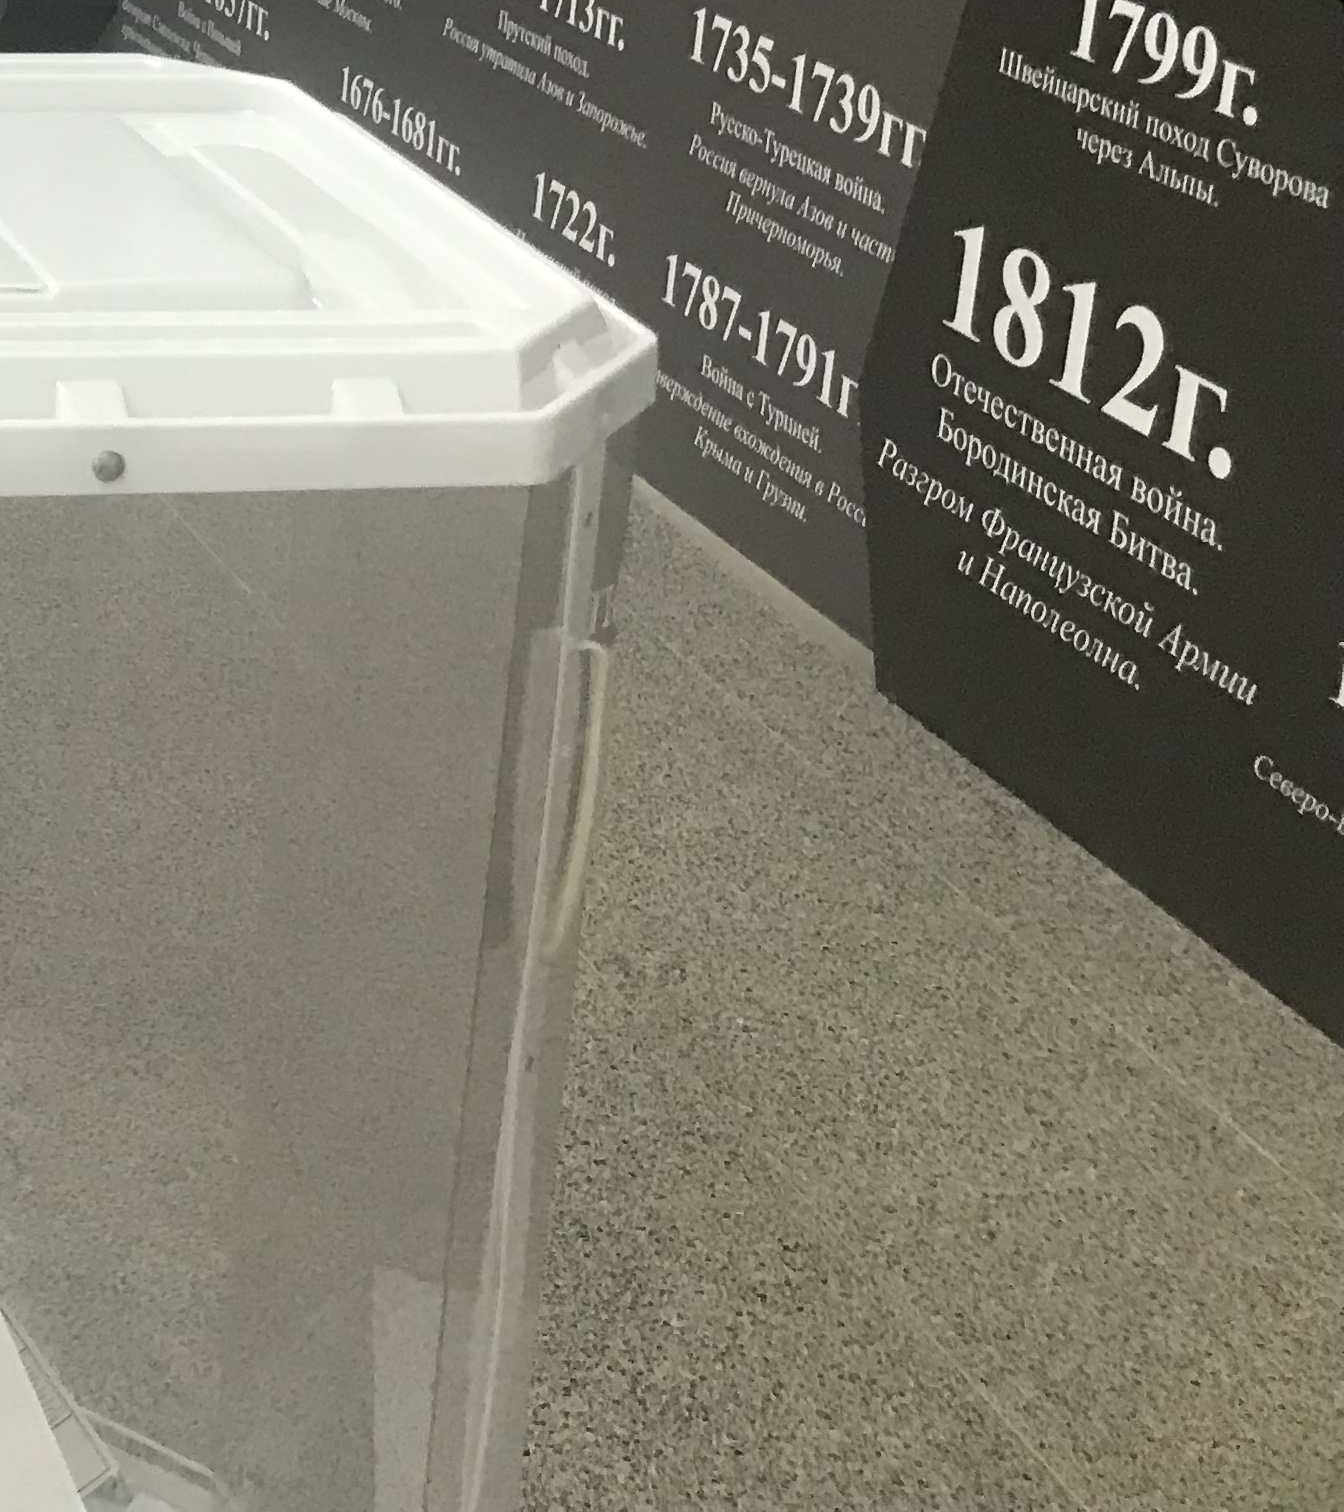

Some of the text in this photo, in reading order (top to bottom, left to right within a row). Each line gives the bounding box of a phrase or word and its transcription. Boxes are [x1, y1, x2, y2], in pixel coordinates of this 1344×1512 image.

[442, 16, 480, 54] Россия
[536, 71, 564, 102] Азов
[565, 89, 575, 107] и
[497, 9, 553, 57] Прутский
[688, 6, 927, 169] 1735-1739гг
[340, 65, 462, 177] 1676-1681гг.
[709, 100, 886, 215] Русско-Турецкая война.
[997, 45, 1330, 210] Швейцарский поход Суворова
[1076, 125, 1220, 209] через Альпы.
[531, 171, 617, 268] 1722г.
[688, 133, 737, 180] Россия
[737, 166, 796, 212] вернула
[795, 194, 835, 233] Азов
[835, 219, 849, 240] и
[724, 189, 844, 278] Причерноморья.
[660, 253, 861, 426] 1787-1791г
[941, 224, 1233, 481] 1812г.
[700, 352, 823, 455] Война с Турцией.
[930, 352, 1225, 553] Отечественная война.
[692, 425, 809, 524] Крыма и Грузии.
[732, 422, 814, 490] вхождения
[813, 479, 826, 498] в
[935, 406, 1200, 597] Бородинская Битва.
[875, 436, 975, 526] Разгром
[979, 506, 1156, 641] Французской
[1157, 622, 1260, 707] Армии
[956, 549, 1141, 692] и Наполеолна.
